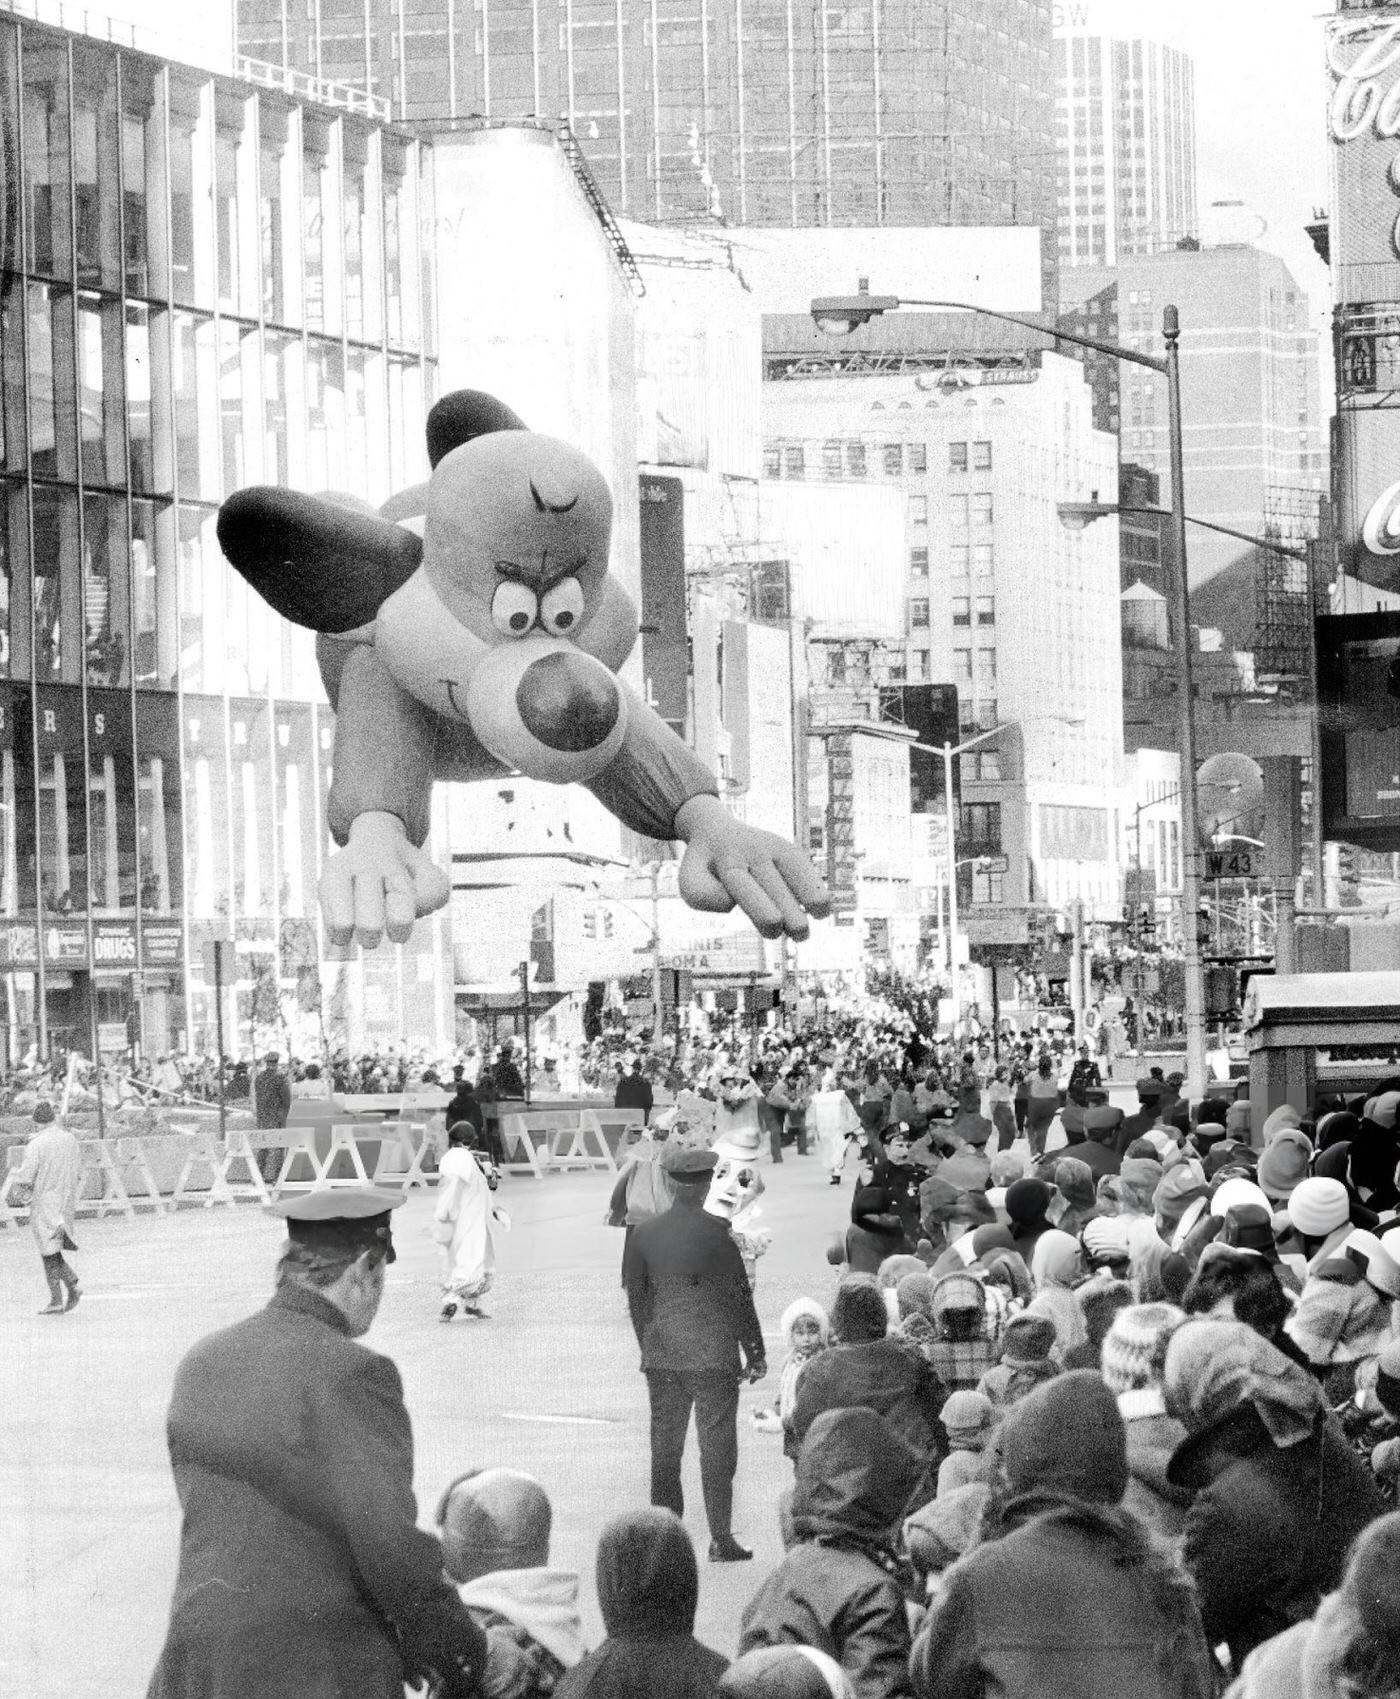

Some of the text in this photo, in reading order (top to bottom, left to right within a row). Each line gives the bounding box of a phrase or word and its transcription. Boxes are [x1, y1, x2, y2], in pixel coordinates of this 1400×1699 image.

[1209, 855, 1223, 874] W
[1228, 854, 1251, 874] 43
[95, 937, 136, 960] DRUGS
